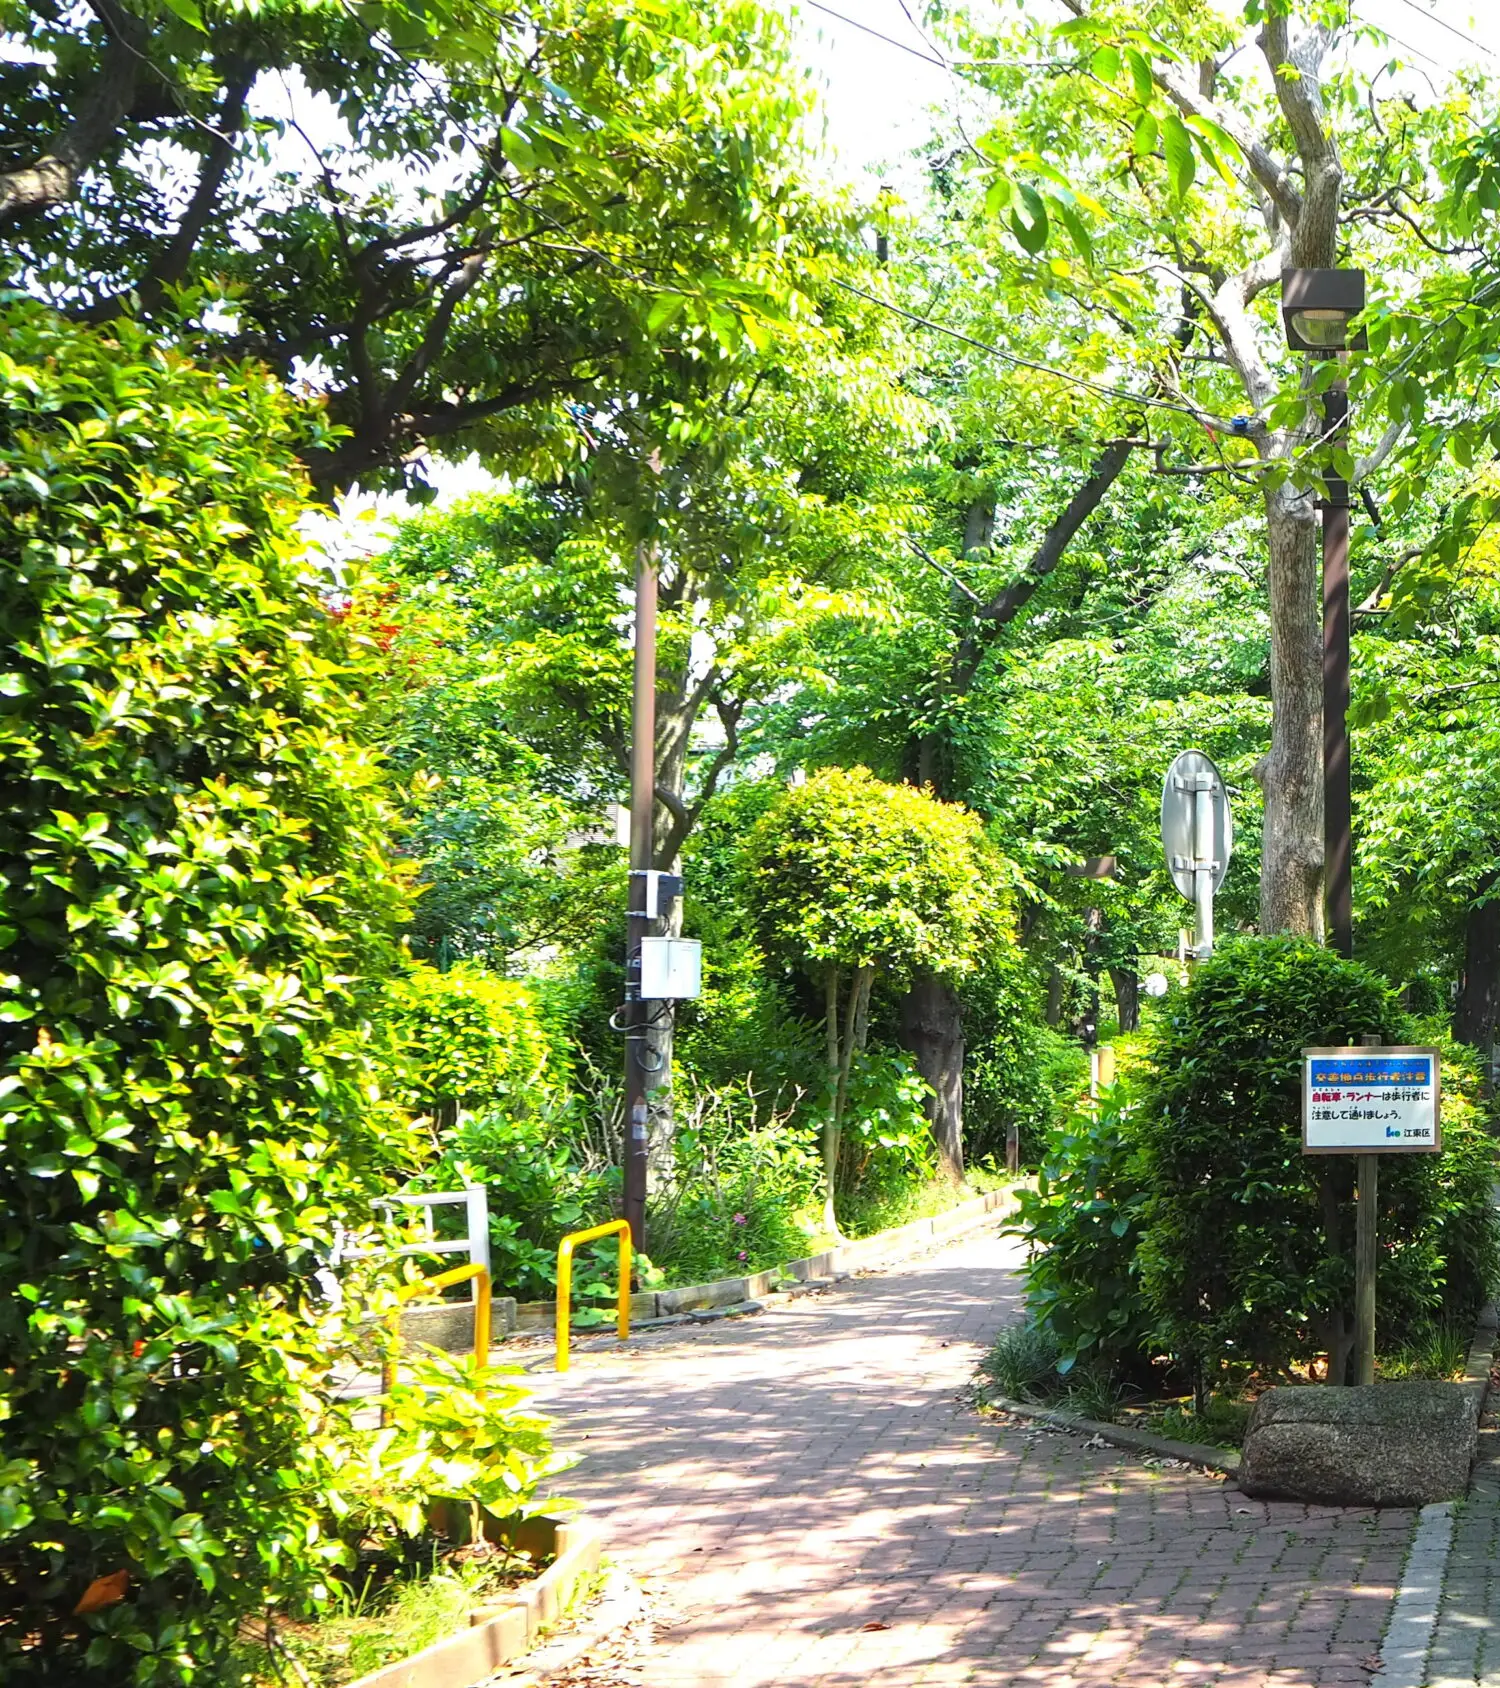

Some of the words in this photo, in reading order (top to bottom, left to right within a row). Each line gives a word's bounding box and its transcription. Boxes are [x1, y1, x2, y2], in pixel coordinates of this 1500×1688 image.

[1312, 1091, 1430, 1102] 自転車・ランナーは歩行者に
[1312, 1109, 1402, 1120] 注意して通りましょう。
[1403, 1128, 1431, 1138] 江東区
